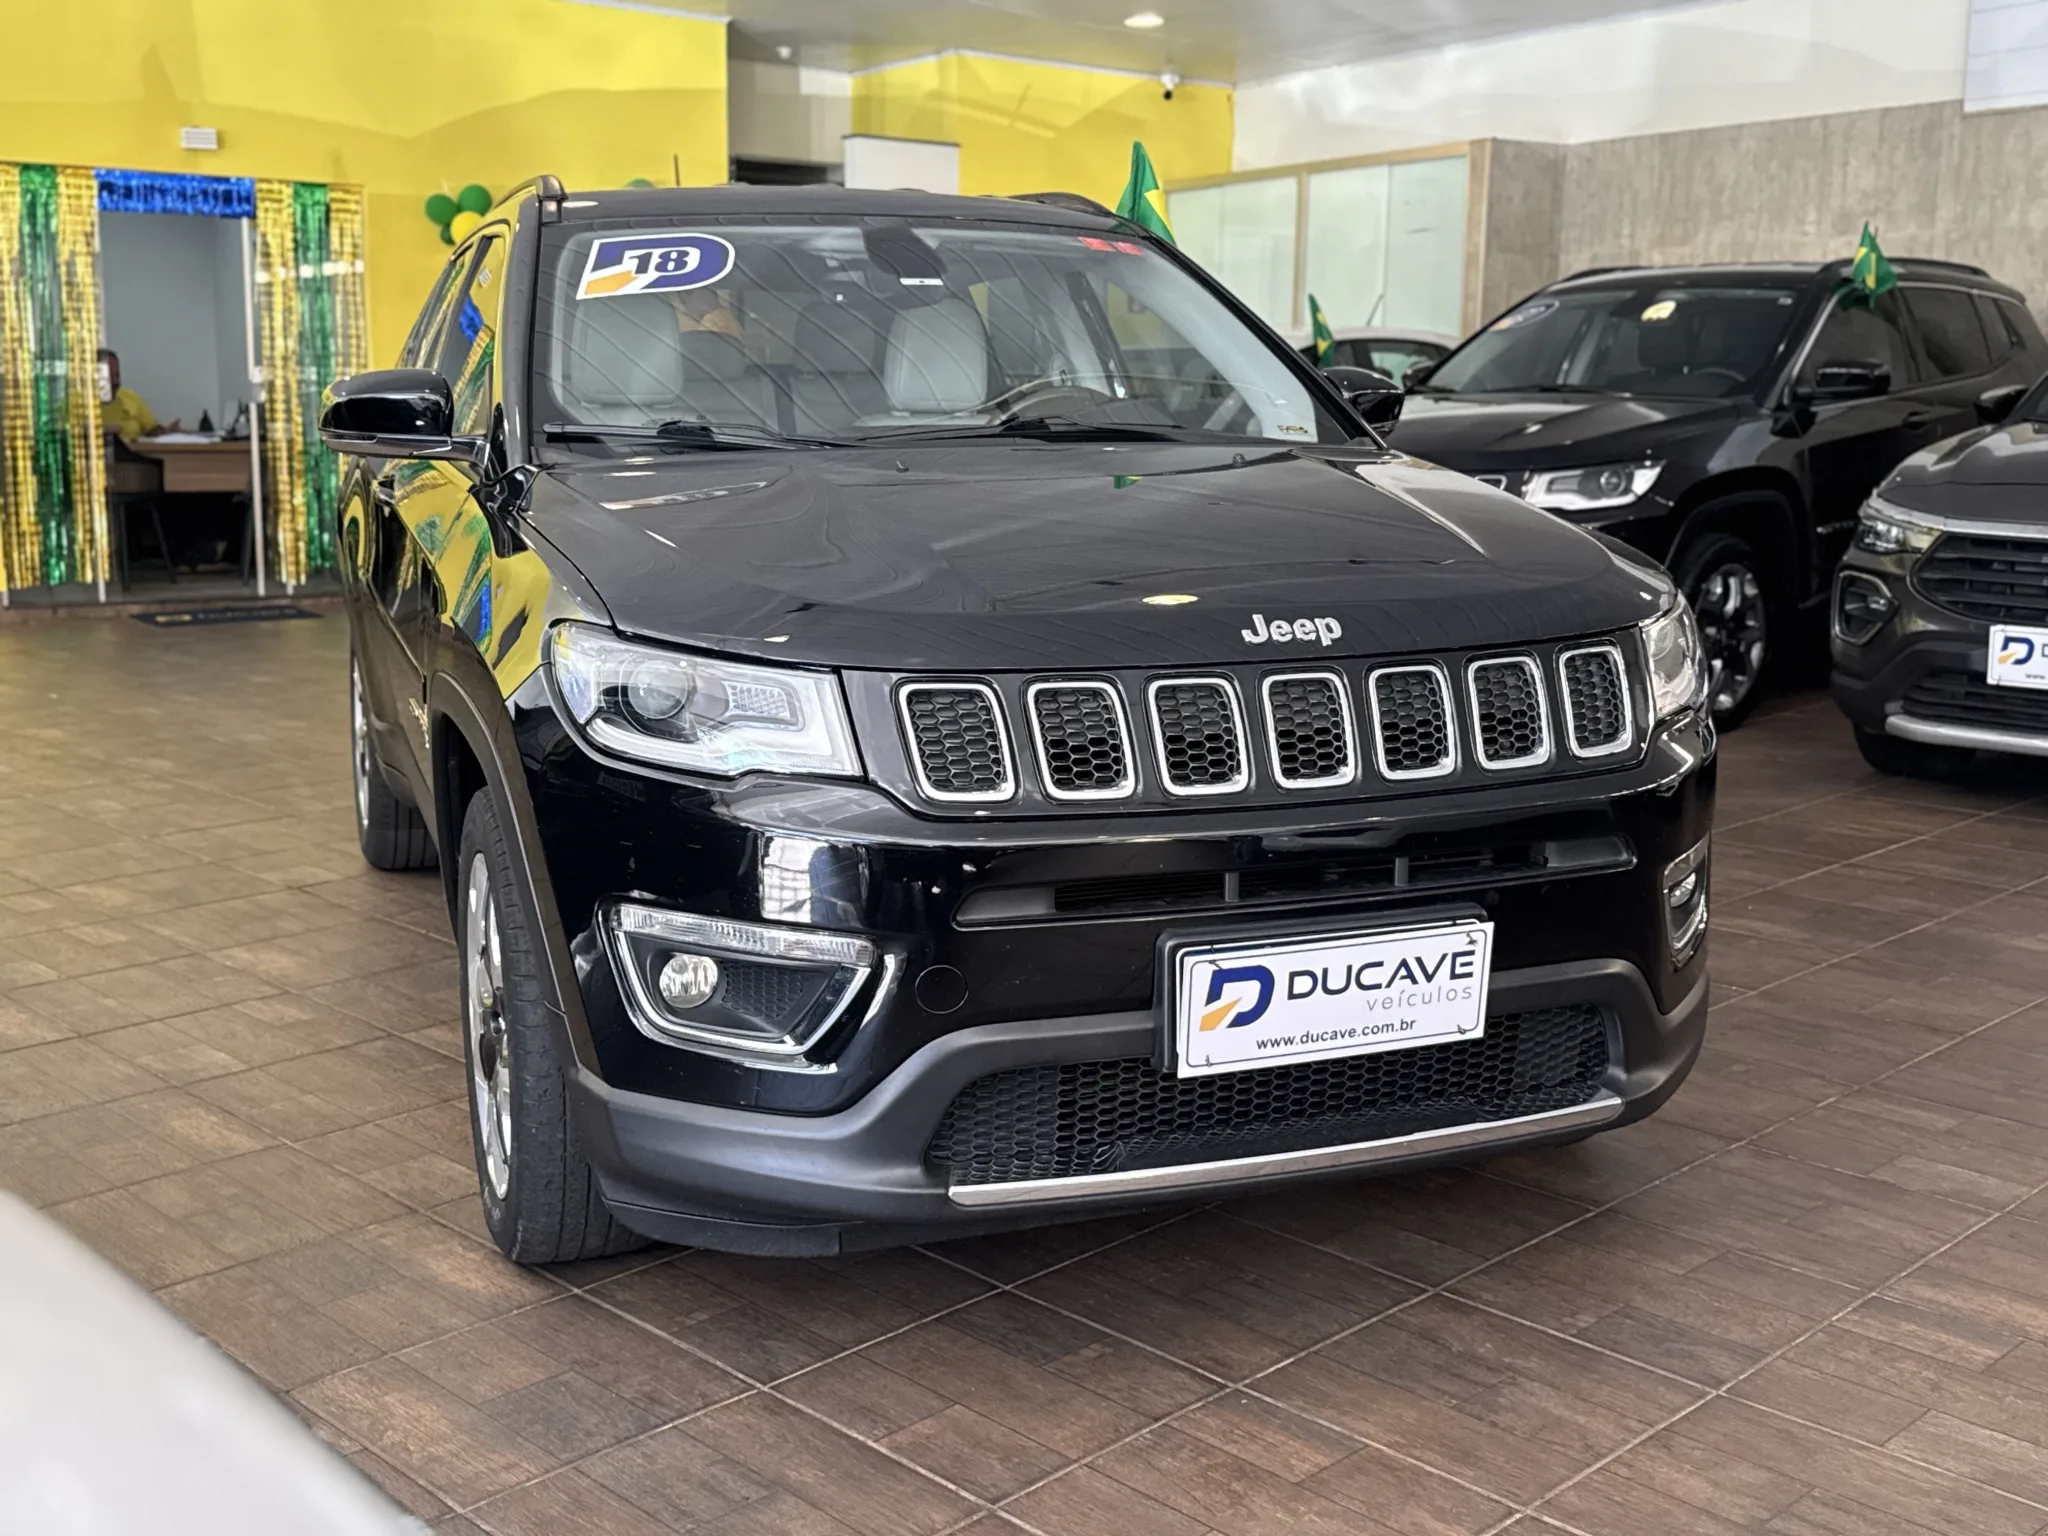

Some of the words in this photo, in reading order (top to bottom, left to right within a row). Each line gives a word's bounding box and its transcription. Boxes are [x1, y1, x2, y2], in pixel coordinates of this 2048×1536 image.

[628, 250, 690, 275] 18
[1241, 614, 1342, 646] Jeep
[1287, 950, 1476, 1000] DUCAVE
[1366, 985, 1473, 1012] veículos
[1256, 1019, 1417, 1050] www.ducave.com.br
